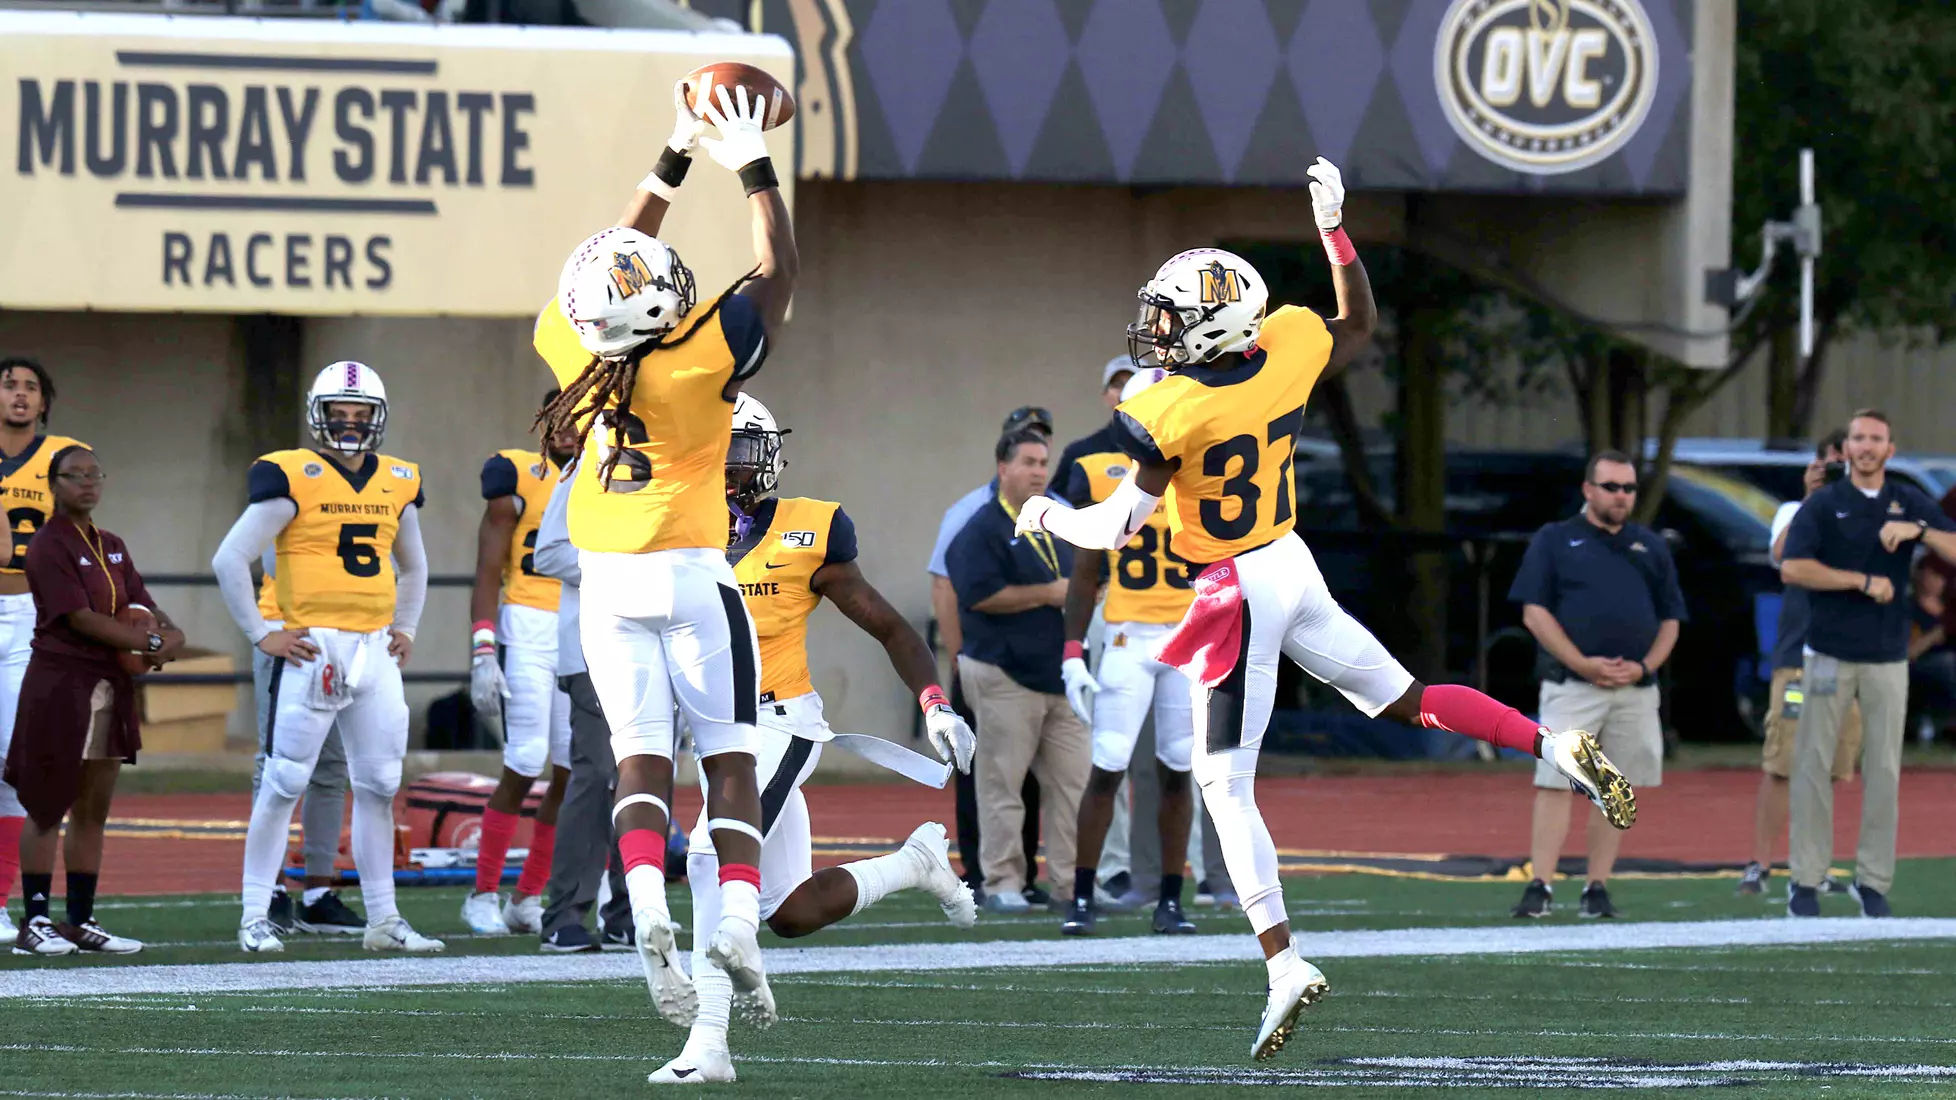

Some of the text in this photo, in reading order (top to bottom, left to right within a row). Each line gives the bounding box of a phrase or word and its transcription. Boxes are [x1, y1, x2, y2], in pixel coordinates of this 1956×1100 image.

[1482, 25, 1607, 108] OVC
[16, 78, 536, 188] MURRAY STATE
[162, 231, 394, 290] RACERS
[1200, 404, 1305, 541] 37
[13, 488, 45, 502] STATE
[320, 503, 389, 516] MURRAY STATE
[782, 531, 815, 547] 150
[738, 582, 780, 597] STATE
